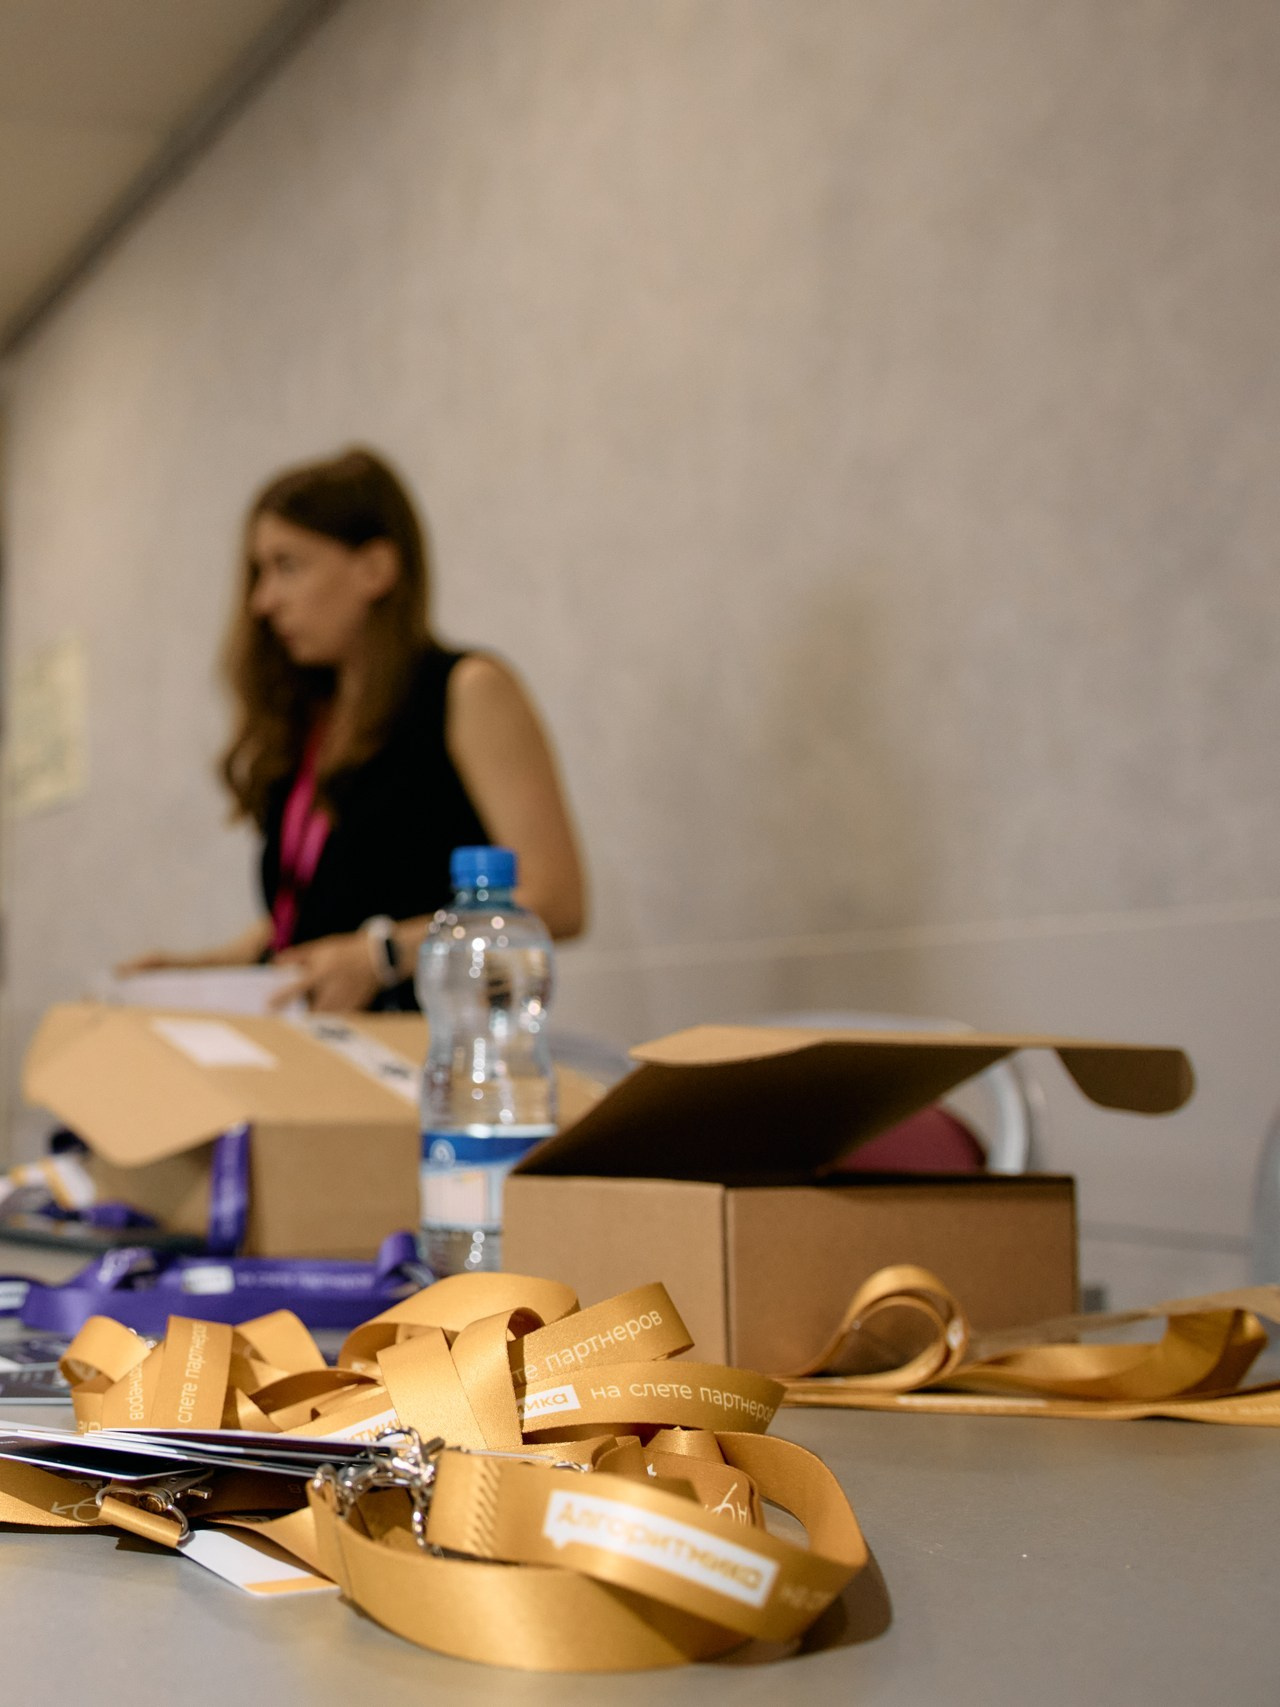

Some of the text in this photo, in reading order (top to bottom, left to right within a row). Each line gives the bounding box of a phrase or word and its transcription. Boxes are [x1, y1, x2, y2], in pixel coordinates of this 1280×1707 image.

[545, 1310, 663, 1372] партнеров
[177, 1382, 198, 1424] слете
[590, 1384, 621, 1400] на
[629, 1382, 693, 1400] слете
